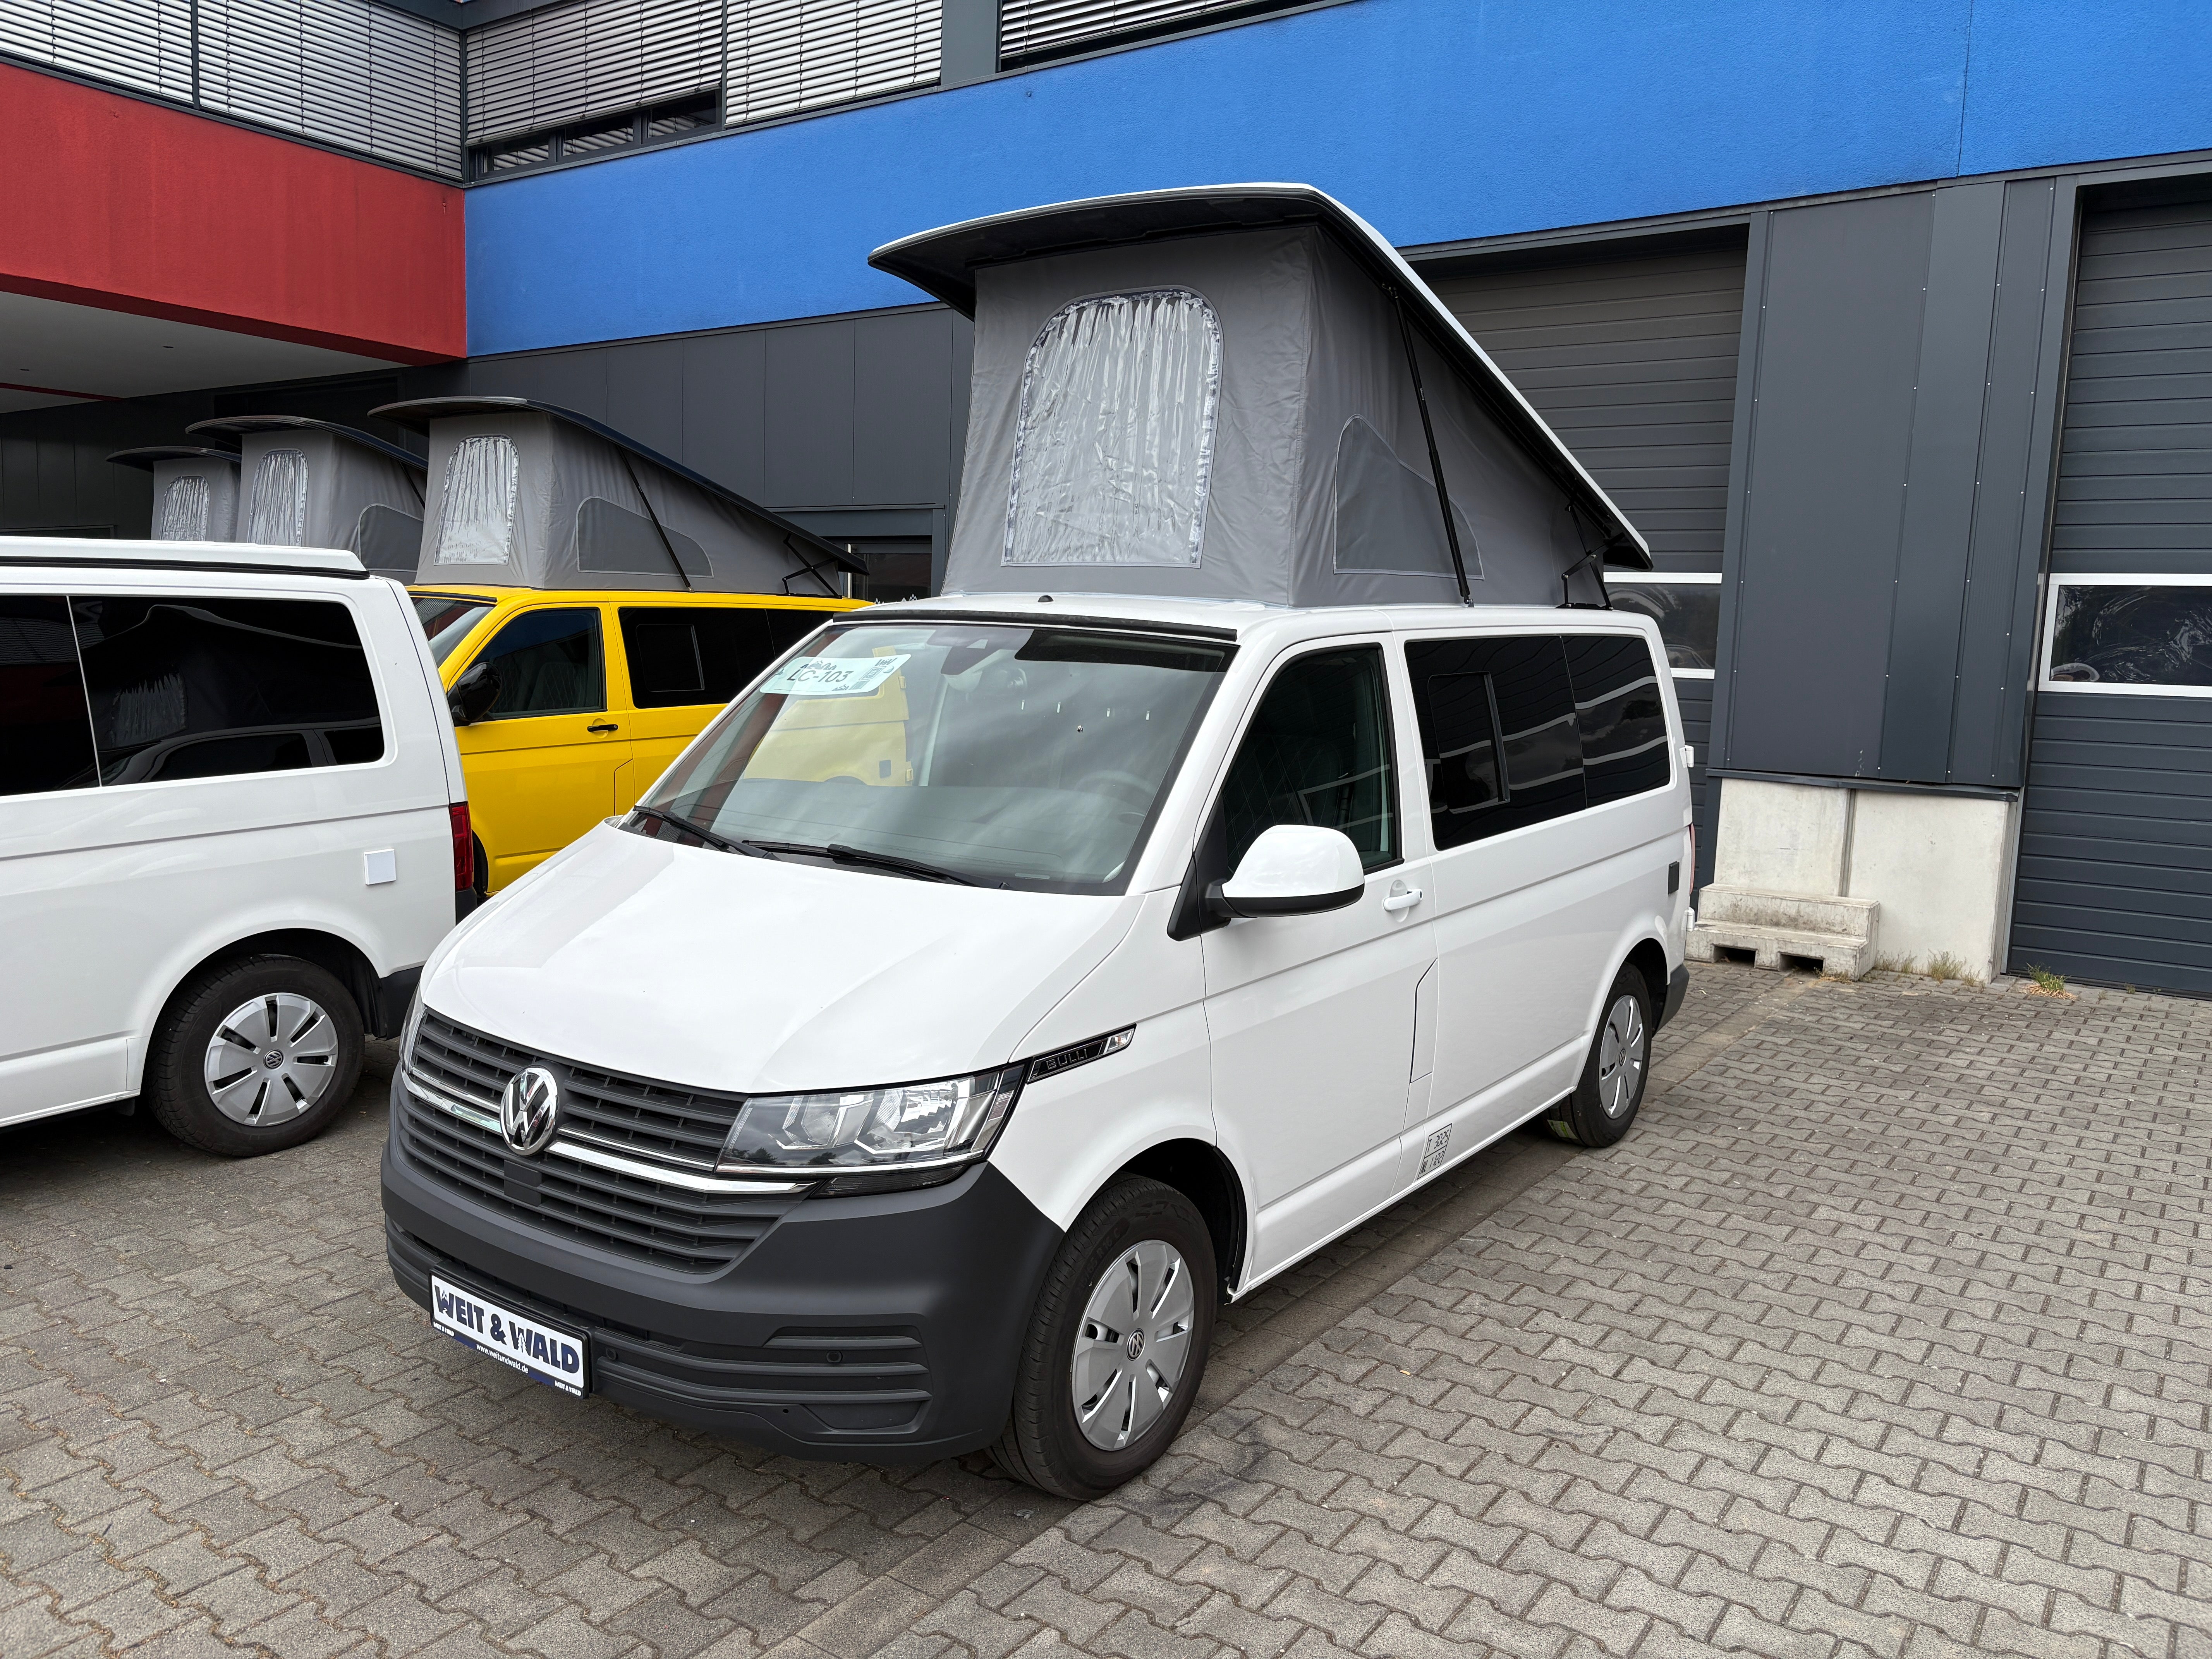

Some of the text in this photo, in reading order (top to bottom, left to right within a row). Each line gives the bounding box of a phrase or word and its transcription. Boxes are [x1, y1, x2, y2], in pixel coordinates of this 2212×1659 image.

[787, 669, 854, 683] LC-103
[1046, 1049, 1087, 1070] BULLI
[500, 1065, 558, 1156] VW
[1427, 1139, 1432, 1152] T
[434, 1285, 580, 1374] WEIT & WALD
[476, 1343, 529, 1374] www.weitundwald.de
